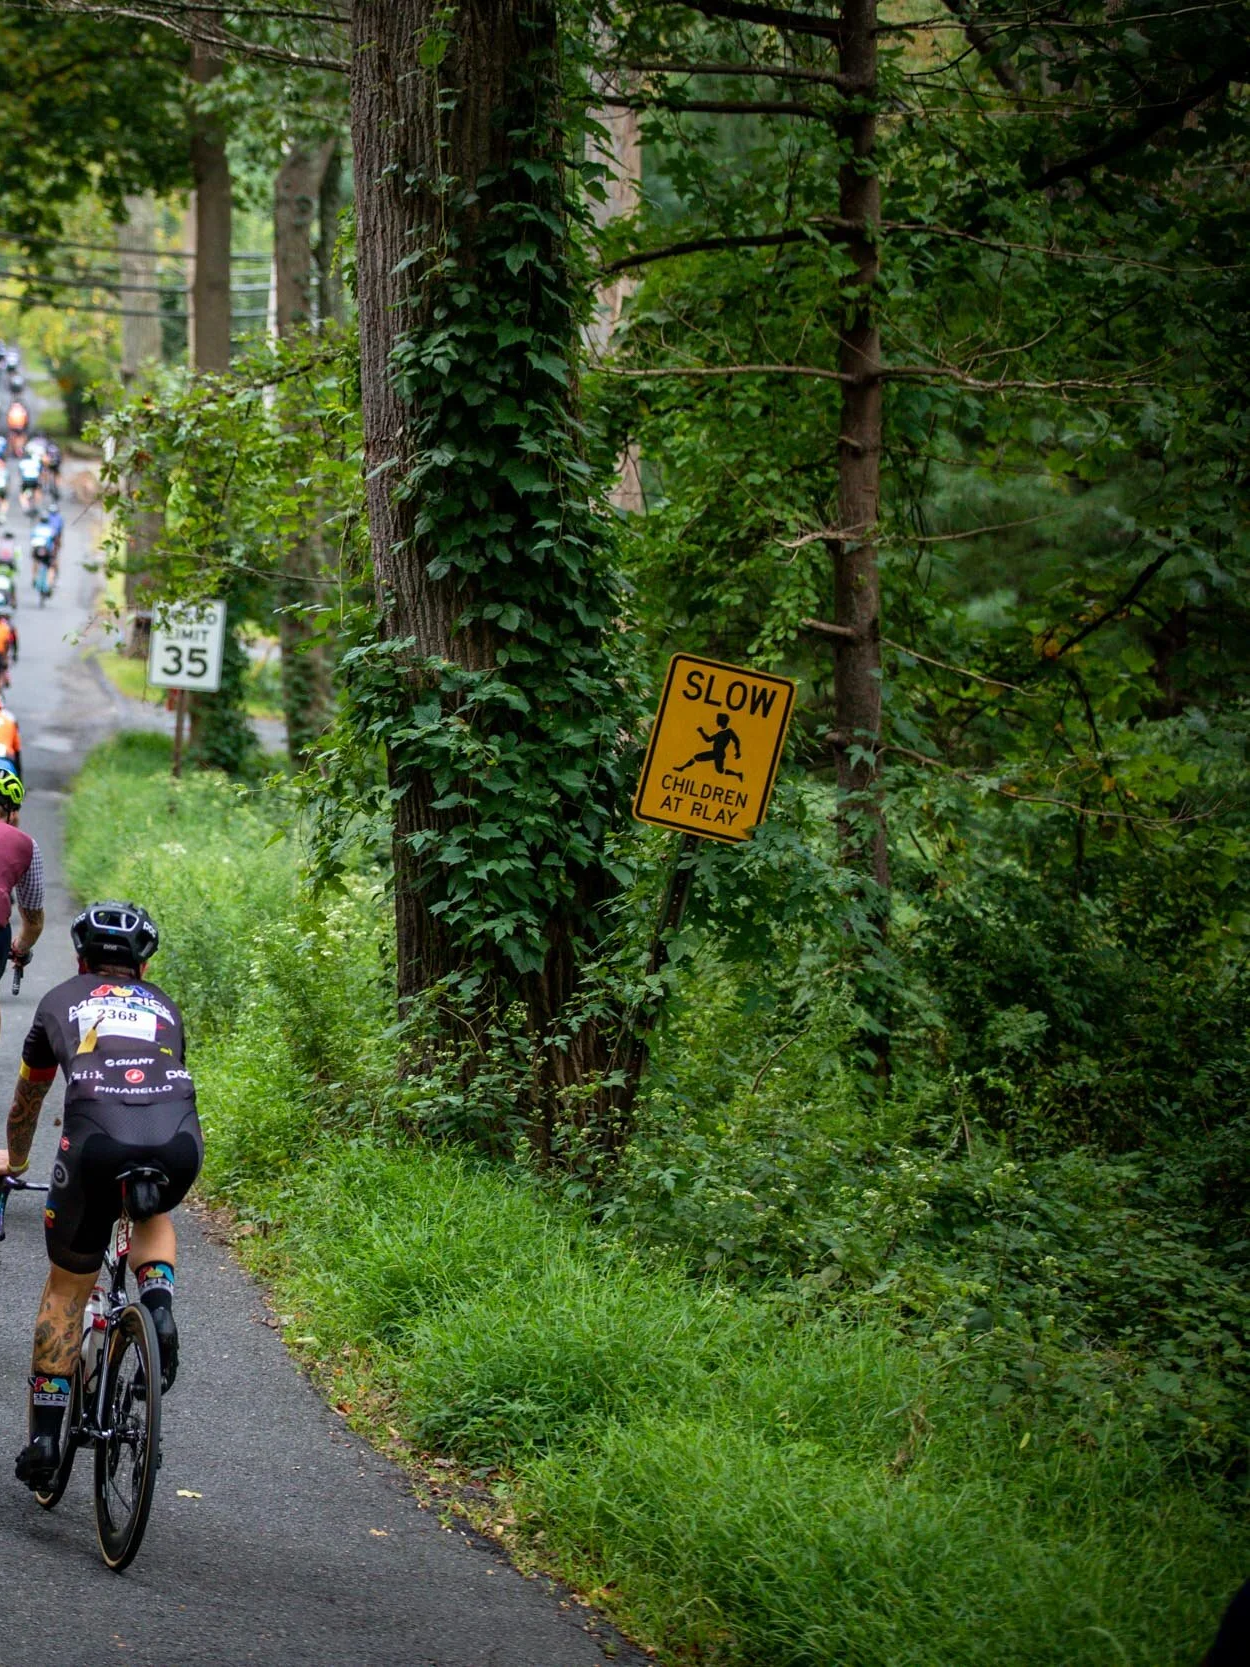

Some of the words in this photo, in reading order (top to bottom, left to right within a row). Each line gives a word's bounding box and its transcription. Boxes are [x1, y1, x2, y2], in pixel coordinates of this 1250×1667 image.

[161, 645, 208, 678] 35
[682, 670, 777, 718] SLOW
[661, 774, 748, 809] CHILDREN
[660, 795, 683, 812] AT
[690, 802, 738, 826] PLAY
[97, 1008, 138, 1022] 2368
[115, 1057, 155, 1066] GIANT
[94, 1084, 173, 1094] PINARELLO
